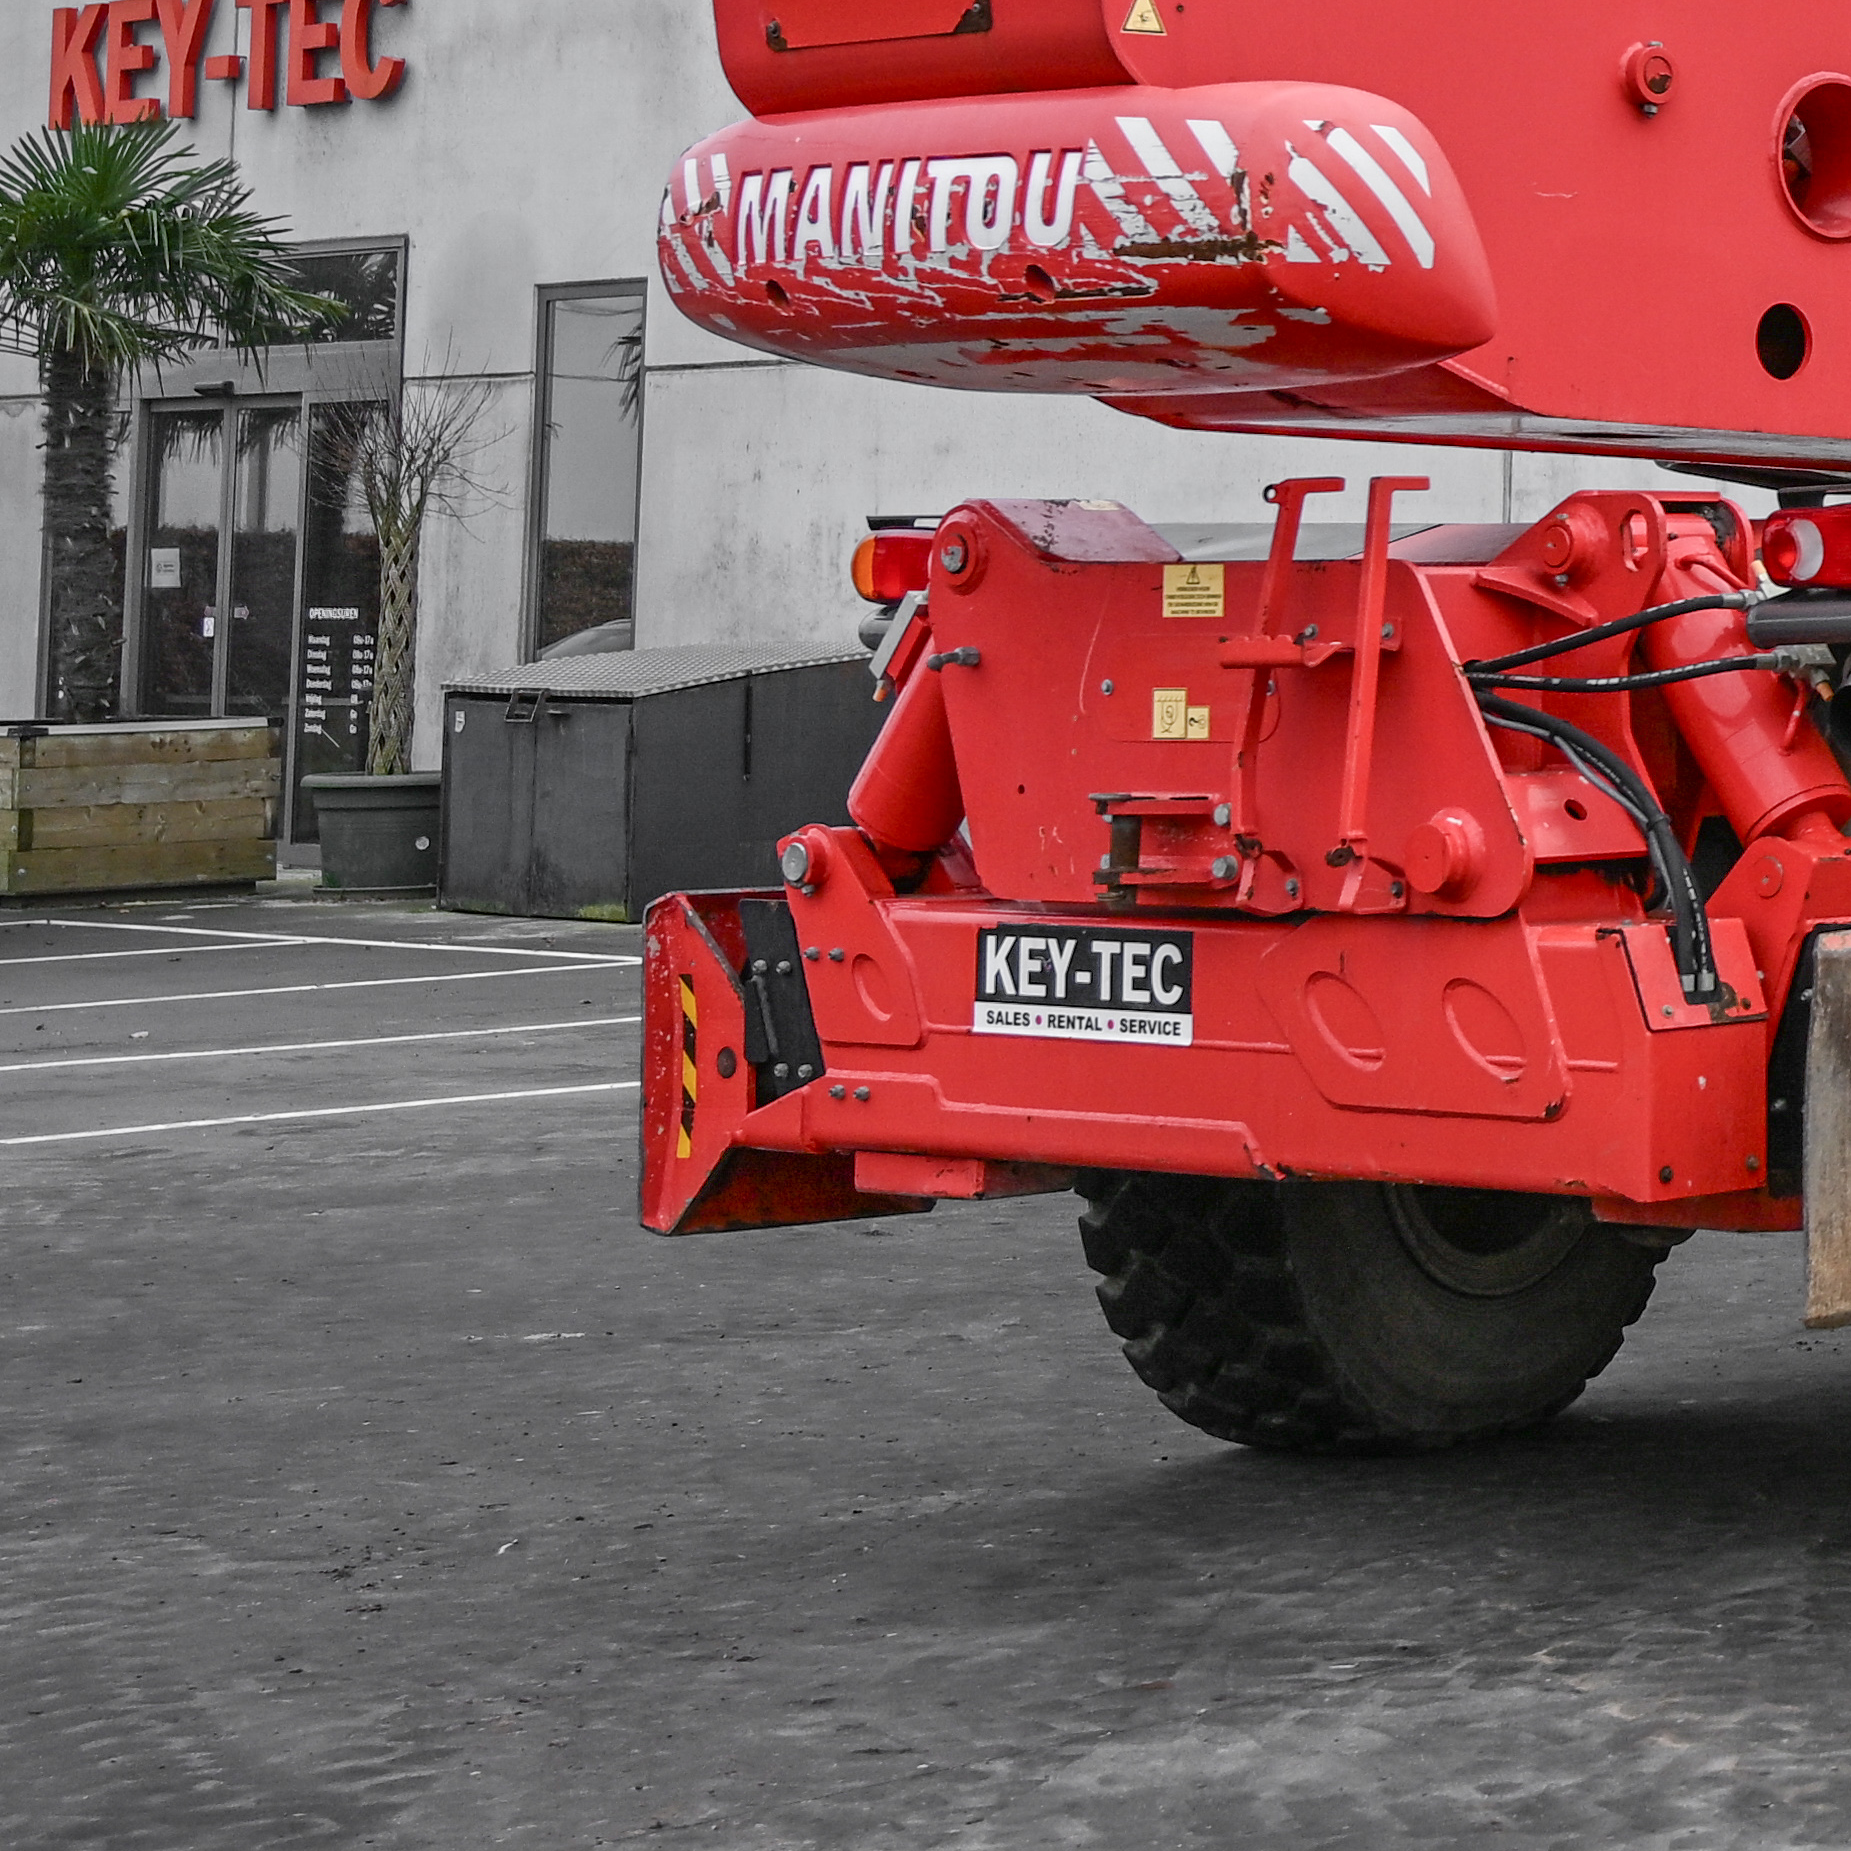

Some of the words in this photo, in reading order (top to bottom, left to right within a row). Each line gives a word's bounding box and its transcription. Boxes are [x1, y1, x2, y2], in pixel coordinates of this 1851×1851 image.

[736, 149, 1085, 266] MANITOU
[984, 934, 1184, 1006] KEY-TEC
[986, 1010, 1031, 1027] SALES
[1047, 1014, 1103, 1031] RENTAL
[1119, 1018, 1182, 1037] SERVICE
